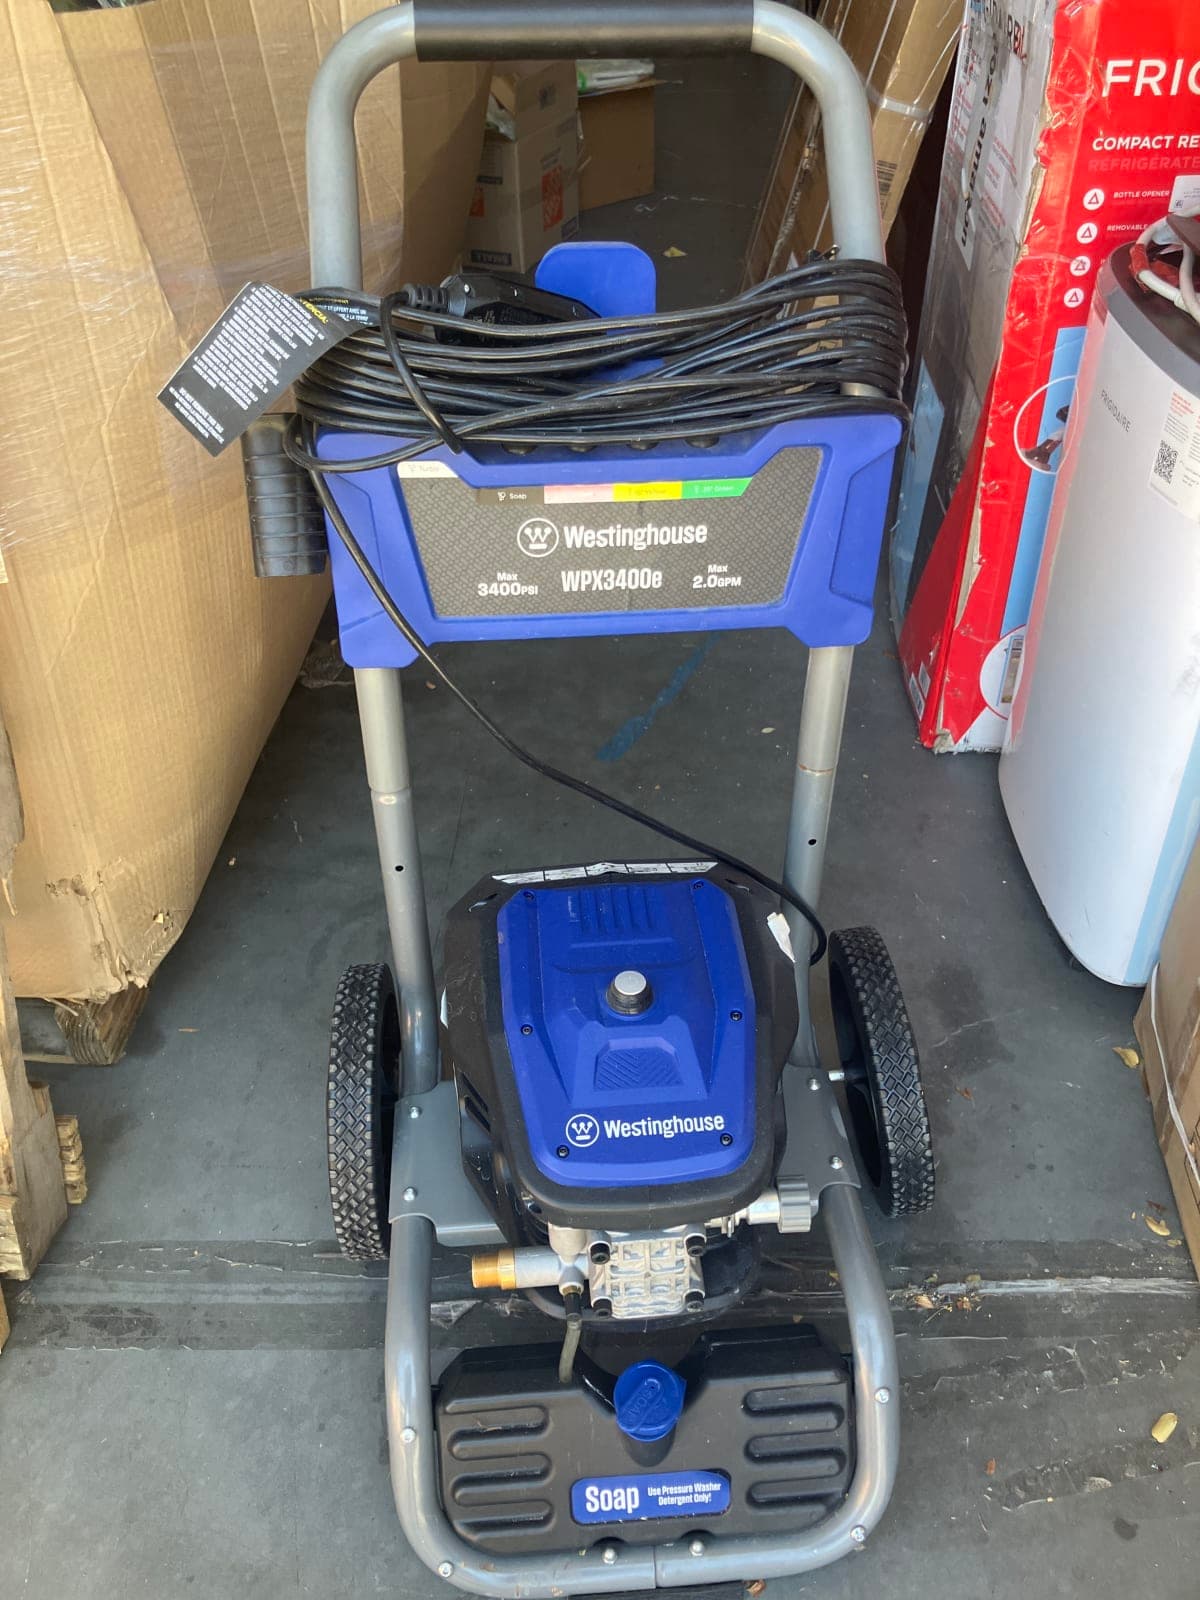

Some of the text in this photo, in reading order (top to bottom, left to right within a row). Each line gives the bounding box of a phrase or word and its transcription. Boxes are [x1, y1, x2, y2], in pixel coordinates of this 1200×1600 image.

[1092, 136, 1174, 151] COMPACT
[1113, 190, 1170, 199] BOTTLE OPENER
[1107, 223, 1149, 232] REMOVABLE
[299, 298, 329, 325] TENCIA:
[1101, 389, 1132, 433] FRIGIDAIRE
[509, 492, 527, 500] Soap
[563, 523, 708, 550] Westinghouse
[708, 564, 728, 574] Max
[497, 572, 518, 582] Max
[561, 567, 663, 592] WPX3400e
[692, 574, 742, 589] 2.0GPM
[604, 1115, 725, 1139] Westinghouse
[648, 1482, 722, 1496] Use Pressure Washer
[585, 1485, 640, 1514] Soap
[658, 1492, 712, 1506] Detergent Only!
